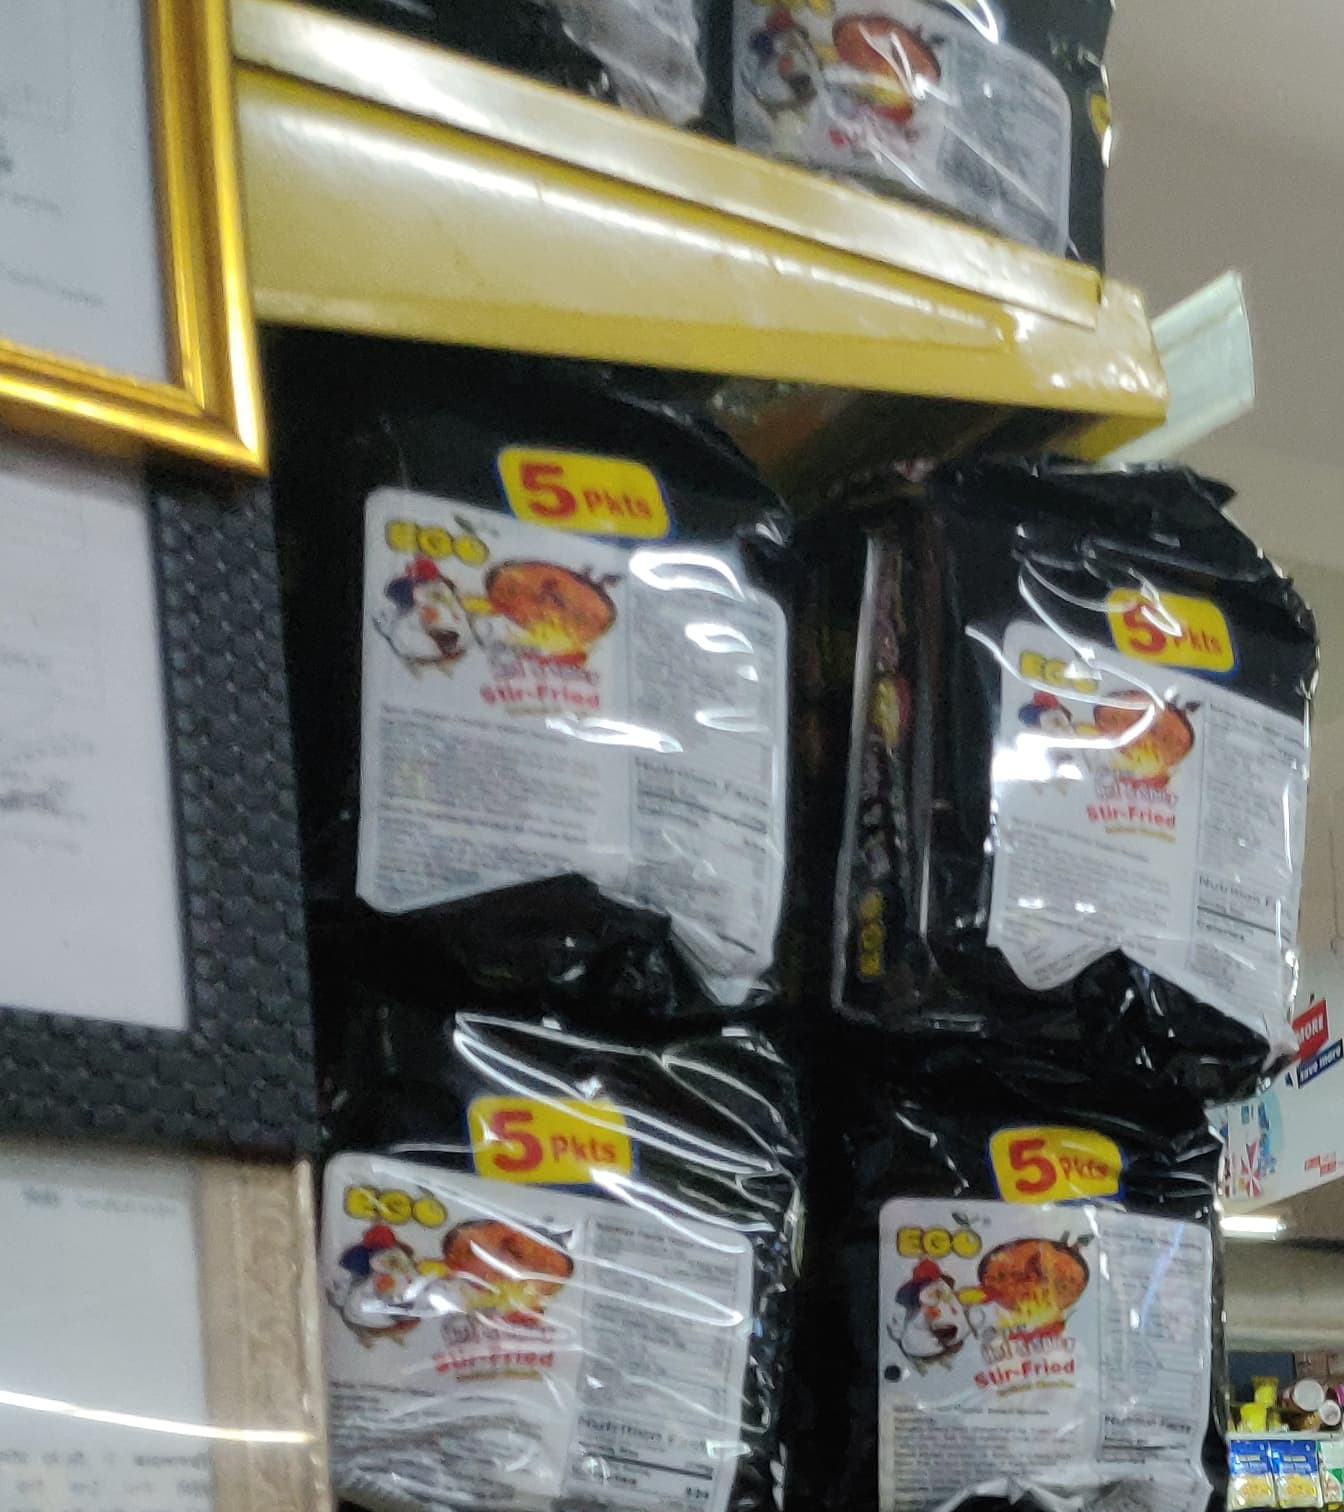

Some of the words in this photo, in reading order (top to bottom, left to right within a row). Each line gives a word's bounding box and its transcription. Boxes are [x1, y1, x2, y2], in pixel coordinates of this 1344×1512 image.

[520, 463, 578, 519] 5
[1122, 601, 1166, 660] 5
[492, 1110, 543, 1172] 5
[551, 1136, 616, 1165] Pkts
[1008, 1138, 1057, 1194] 5
